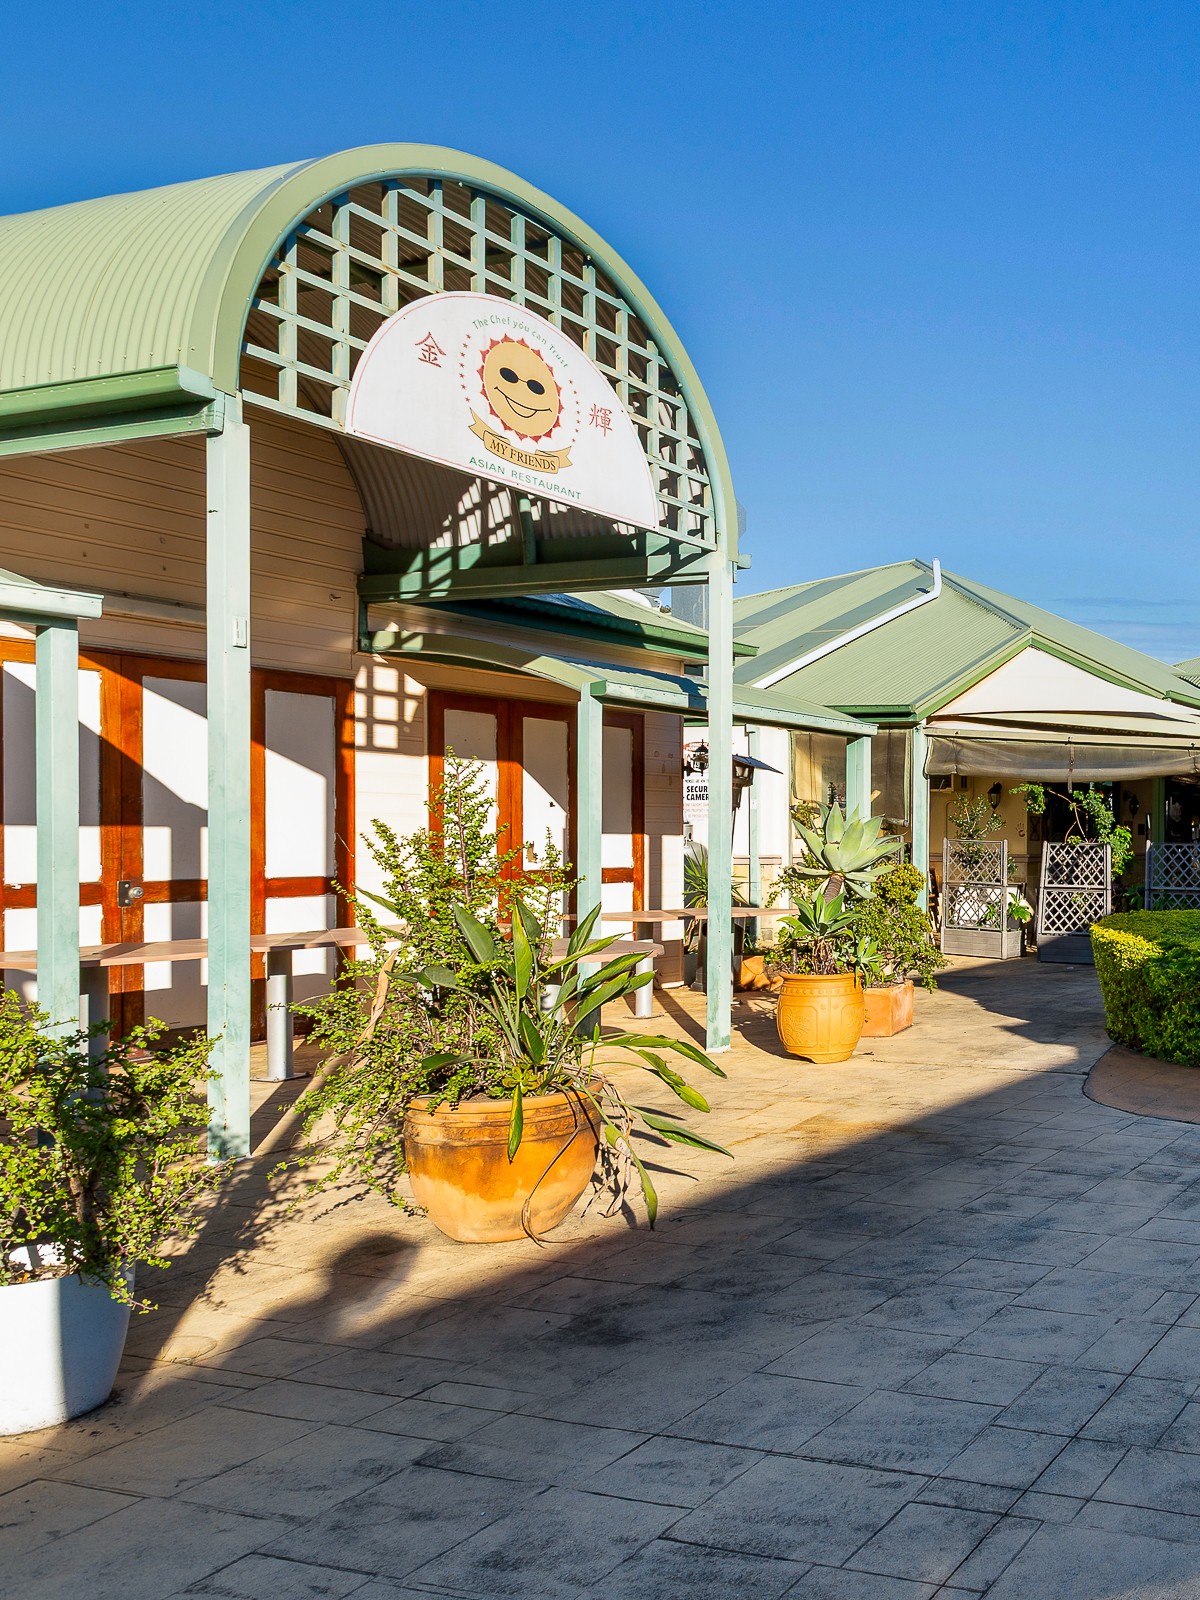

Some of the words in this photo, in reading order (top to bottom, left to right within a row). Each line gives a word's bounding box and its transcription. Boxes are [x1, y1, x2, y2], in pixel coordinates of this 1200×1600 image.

[414, 331, 447, 368] 金
[472, 318, 489, 330] The
[489, 314, 510, 325] Chef
[512, 320, 530, 333] you
[532, 331, 547, 345] can
[548, 344, 569, 368] Trust
[588, 403, 613, 438] 輝
[489, 440, 508, 456] MY
[509, 448, 556, 471] FRIENDS
[469, 456, 505, 475] ASIAN
[511, 470, 582, 500] RESTAURANT
[686, 785, 709, 793] SECUR
[686, 793, 709, 801] CAMER
